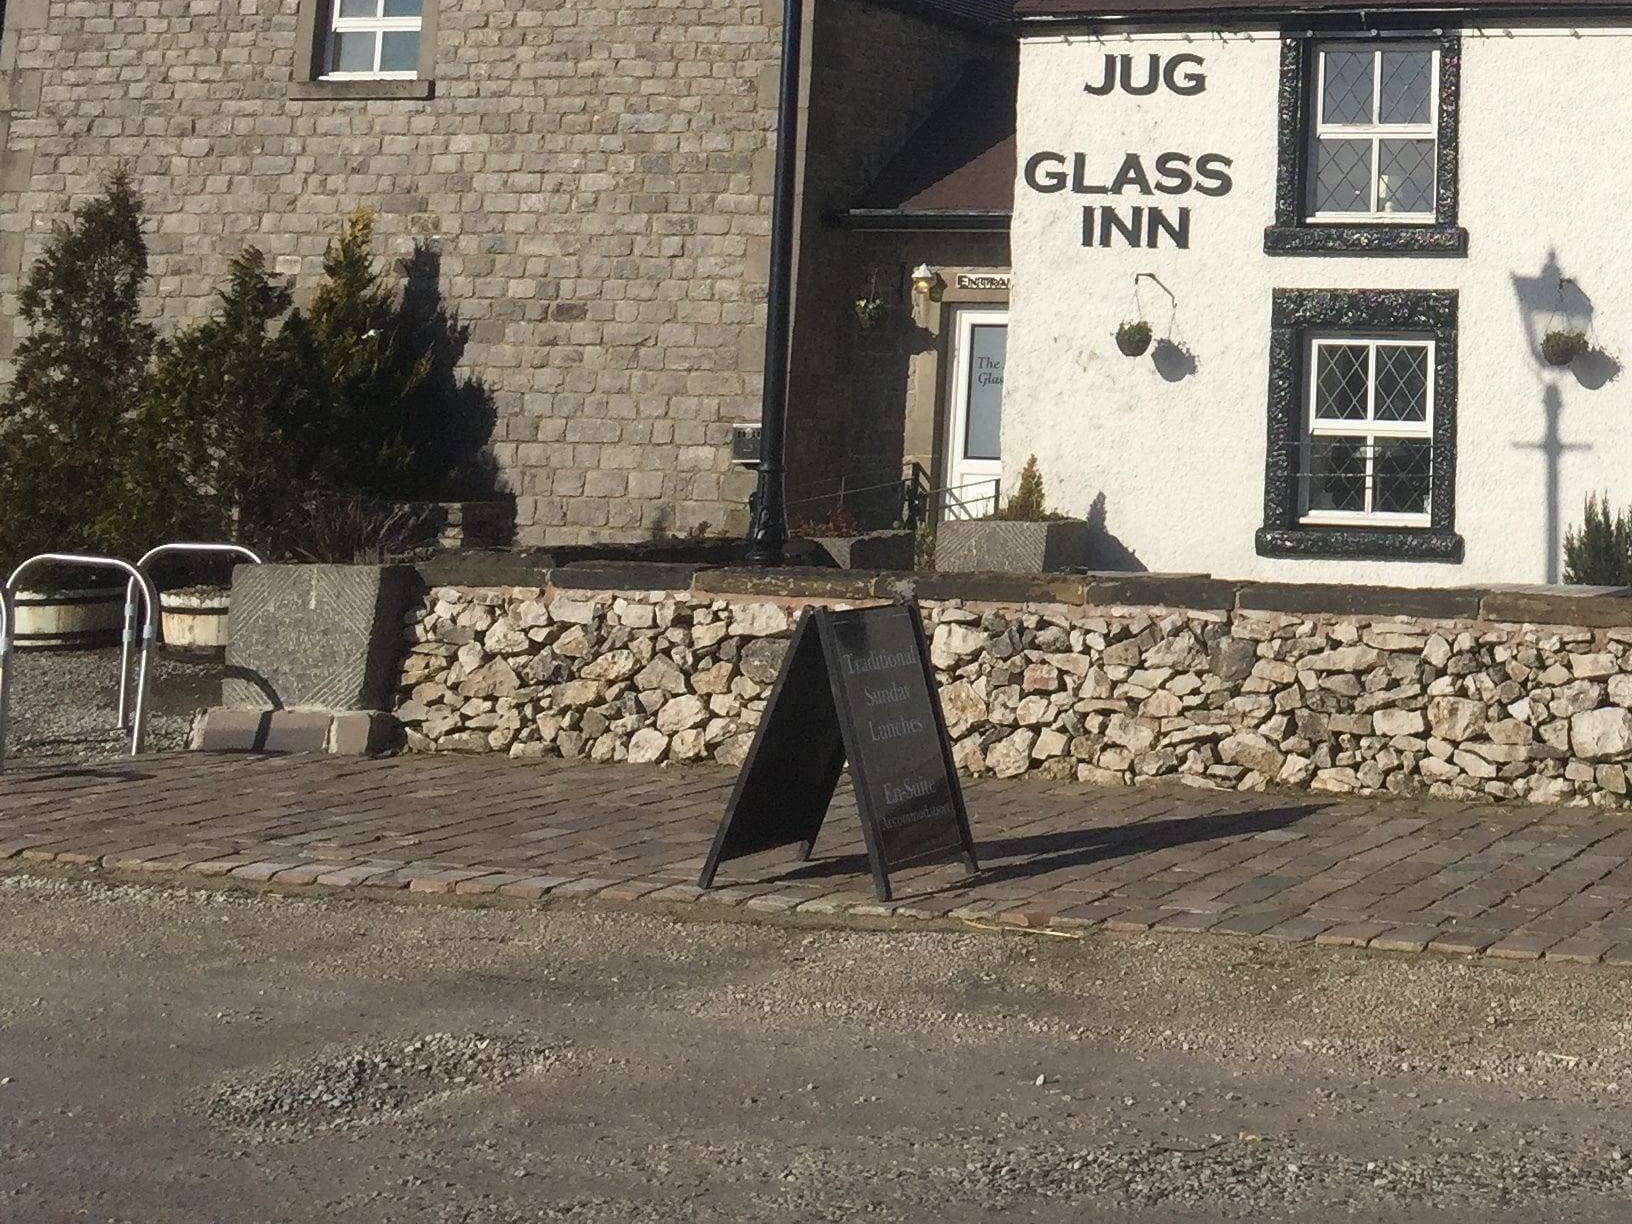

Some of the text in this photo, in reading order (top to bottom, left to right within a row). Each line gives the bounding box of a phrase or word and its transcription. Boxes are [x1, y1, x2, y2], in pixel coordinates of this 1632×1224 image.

[1084, 53, 1207, 96] JUG
[1024, 151, 1233, 196] GLASS
[1081, 205, 1191, 249] INN
[977, 357, 1000, 369] The
[978, 373, 1004, 388] Glas
[843, 645, 917, 674] Traditional
[868, 715, 923, 742] Lunches
[883, 776, 936, 805] En-Suite
